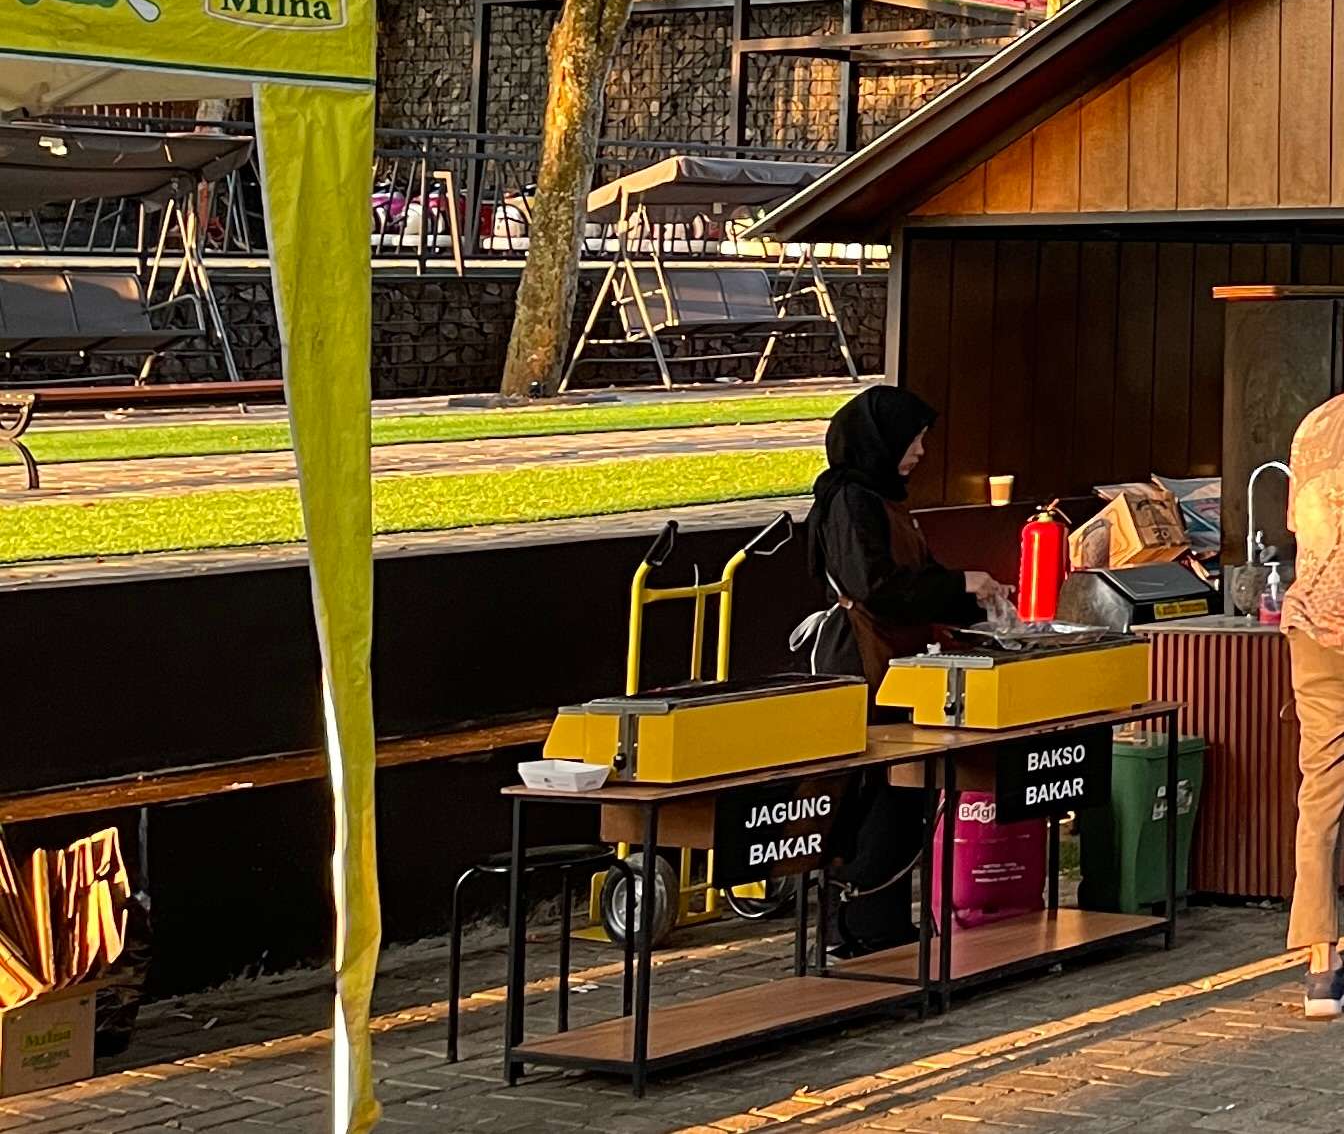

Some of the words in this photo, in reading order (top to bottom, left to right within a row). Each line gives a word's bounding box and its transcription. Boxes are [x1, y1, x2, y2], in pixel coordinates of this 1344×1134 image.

[1027, 744, 1085, 772] BAKSO
[1026, 777, 1084, 805] BAKAR
[745, 795, 831, 828] JAGUNG
[749, 833, 822, 866] BAKAR
